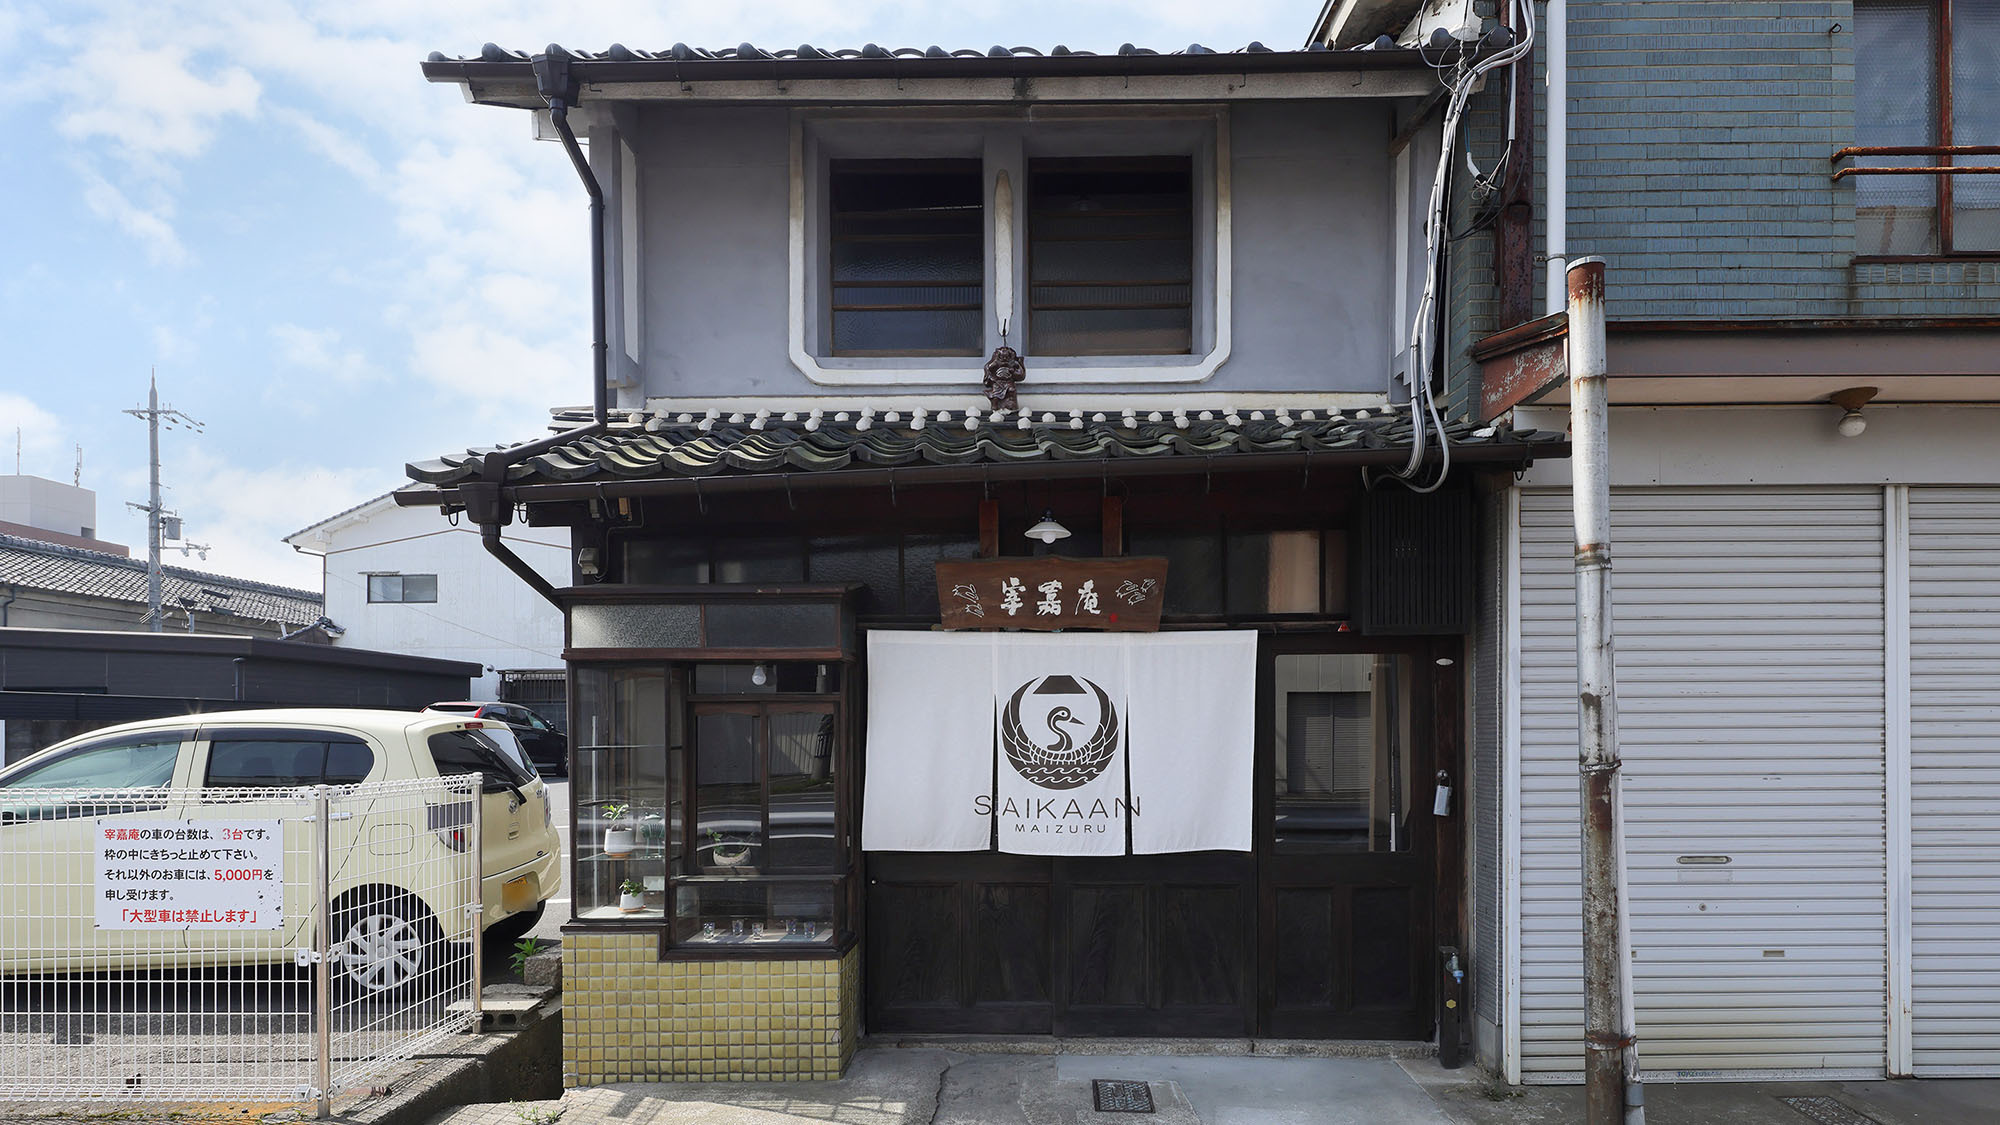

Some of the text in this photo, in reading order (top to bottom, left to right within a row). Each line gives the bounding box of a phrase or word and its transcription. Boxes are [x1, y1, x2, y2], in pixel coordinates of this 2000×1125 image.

[974, 795, 1141, 819] SAIKAAN
[1015, 824, 1106, 833] MAIZURU
[104, 849, 259, 861] 枠の中にきちっと止めて下さい。
[104, 869, 274, 883] それ以外のお車には、5,000円を
[105, 889, 174, 901] 申し受けます。
[122, 909, 257, 924] 「大型車は禁止します」
